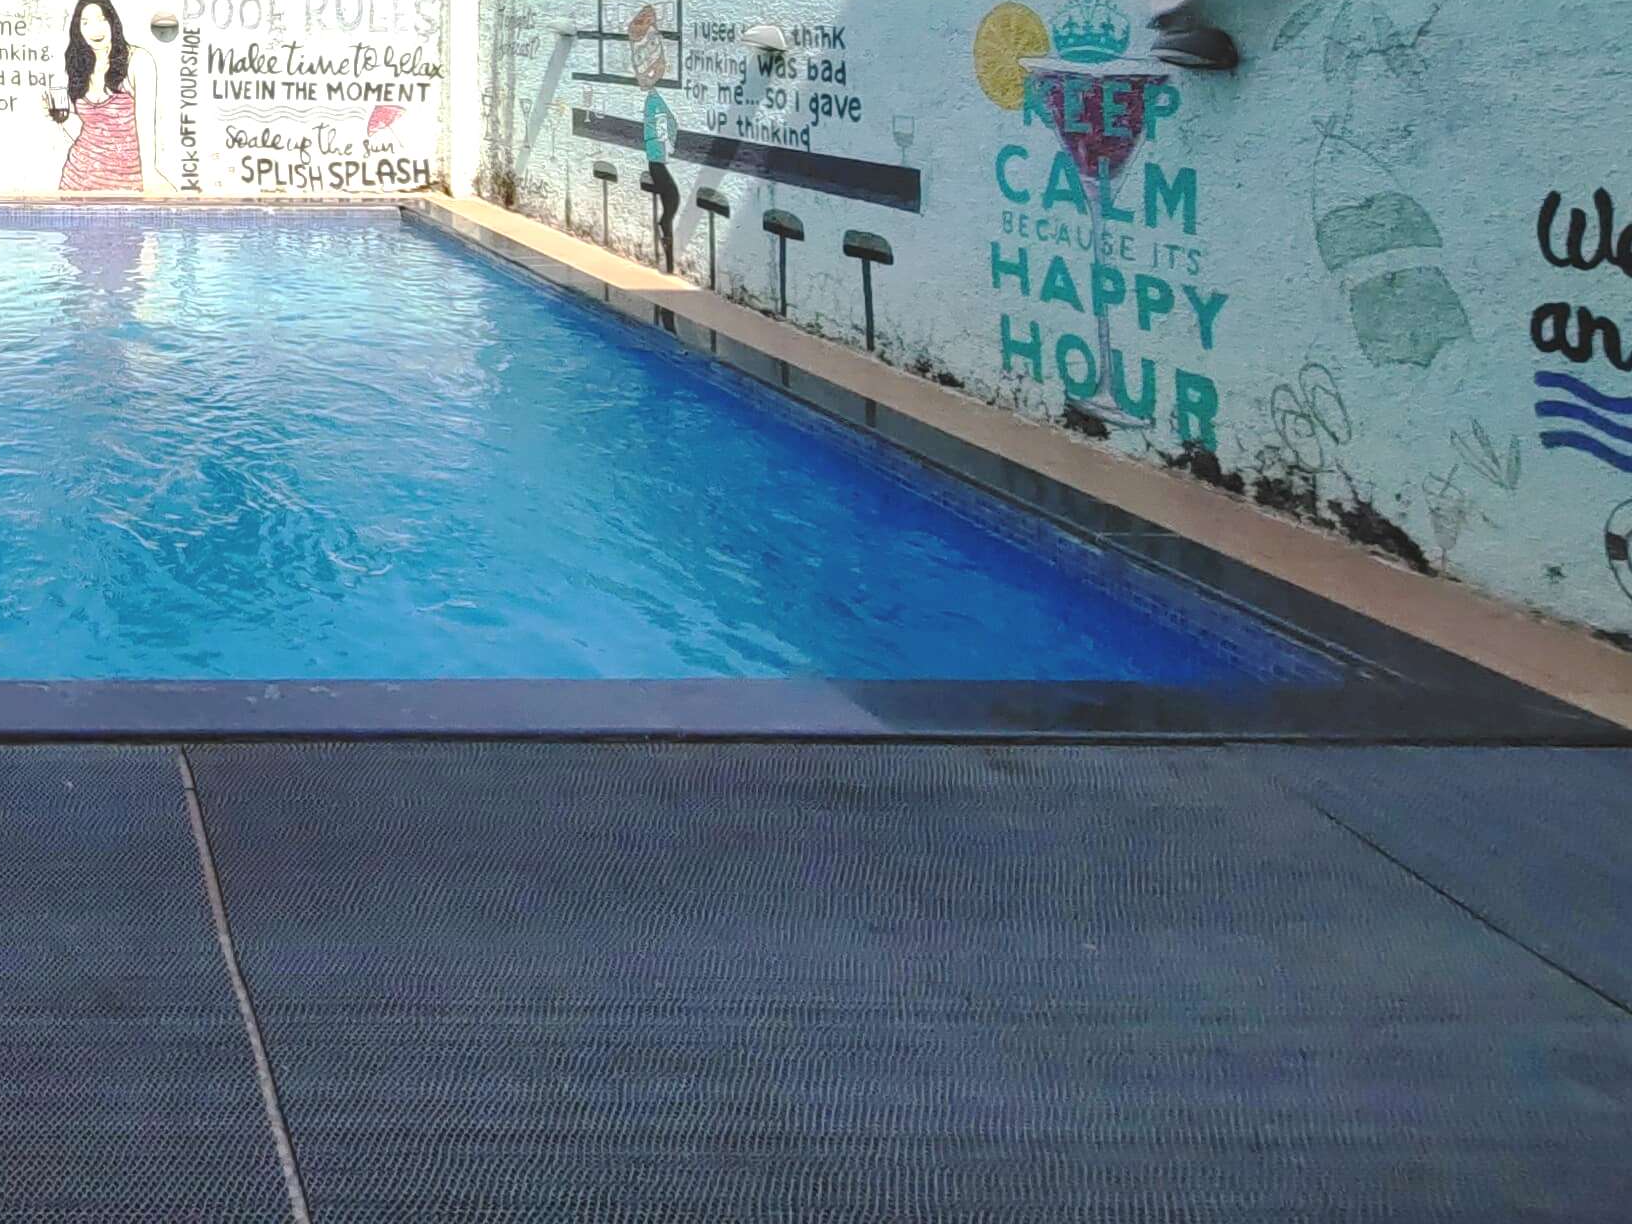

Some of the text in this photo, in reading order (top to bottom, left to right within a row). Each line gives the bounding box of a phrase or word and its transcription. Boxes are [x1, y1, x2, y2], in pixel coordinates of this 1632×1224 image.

[702, 22, 736, 42] used
[208, 43, 281, 75] Make
[281, 40, 350, 75] time
[350, 42, 380, 78] to
[684, 50, 748, 85] drinking
[807, 59, 847, 86] bad
[10, 69, 21, 86] a
[28, 70, 55, 87] bar
[281, 81, 317, 101] THE
[326, 81, 431, 102] MOMENT
[683, 80, 708, 99] for
[809, 93, 862, 127] gave
[1023, 75, 1182, 142] KEEP
[180, 112, 196, 148] OFF
[312, 122, 353, 156] the
[736, 115, 811, 152] thinking
[180, 150, 201, 192] KICK
[241, 155, 431, 192] SPLISH SPLASH
[995, 143, 1198, 236] CALM
[1002, 210, 1137, 261] BECAUSE
[990, 241, 1230, 351] HAPPY
[1000, 313, 1218, 453] HOUR
